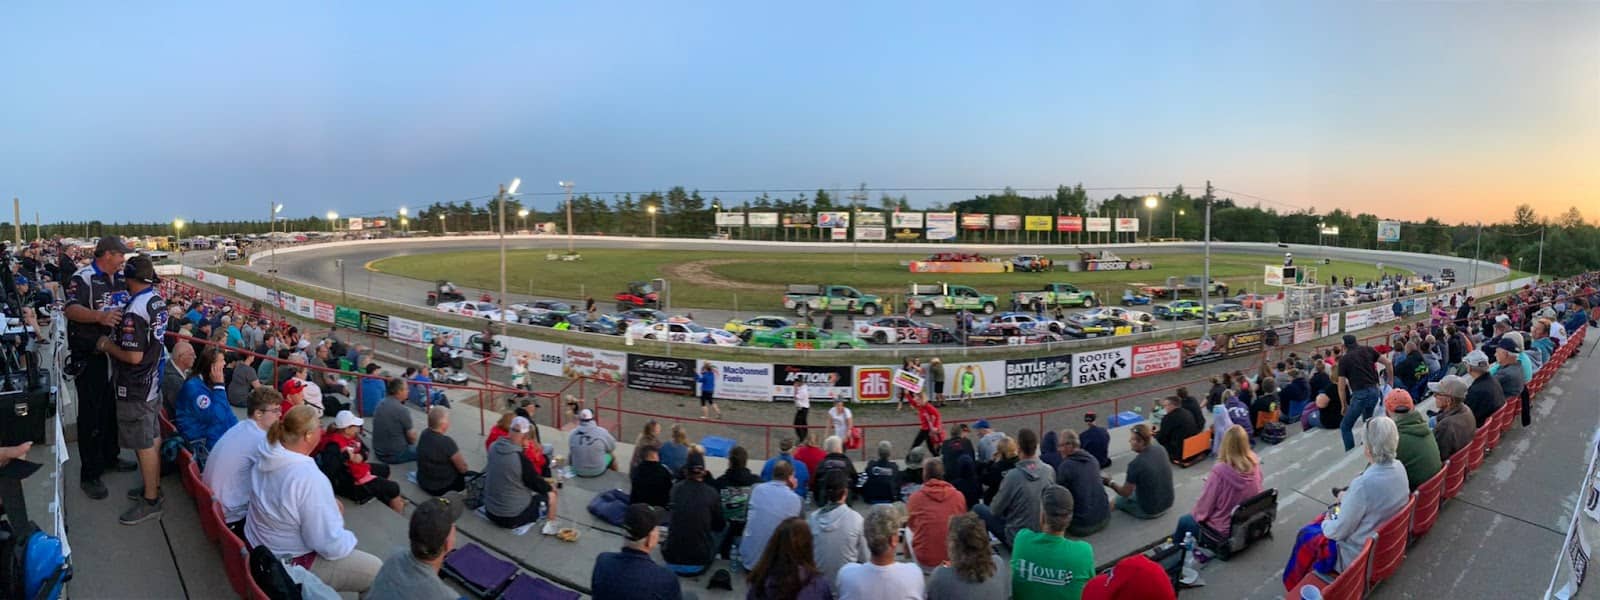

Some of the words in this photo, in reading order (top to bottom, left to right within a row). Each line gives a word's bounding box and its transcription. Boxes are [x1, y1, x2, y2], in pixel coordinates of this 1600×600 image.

[541, 353, 561, 364] 1059
[1079, 350, 1121, 363] ROOTE'S
[723, 366, 769, 376] MacDonnell
[1007, 361, 1046, 374] BATTLE
[1079, 363, 1107, 374] GAS
[723, 374, 743, 383] Fuels
[1007, 372, 1046, 389] BEACH
[1079, 373, 1106, 384] BAR
